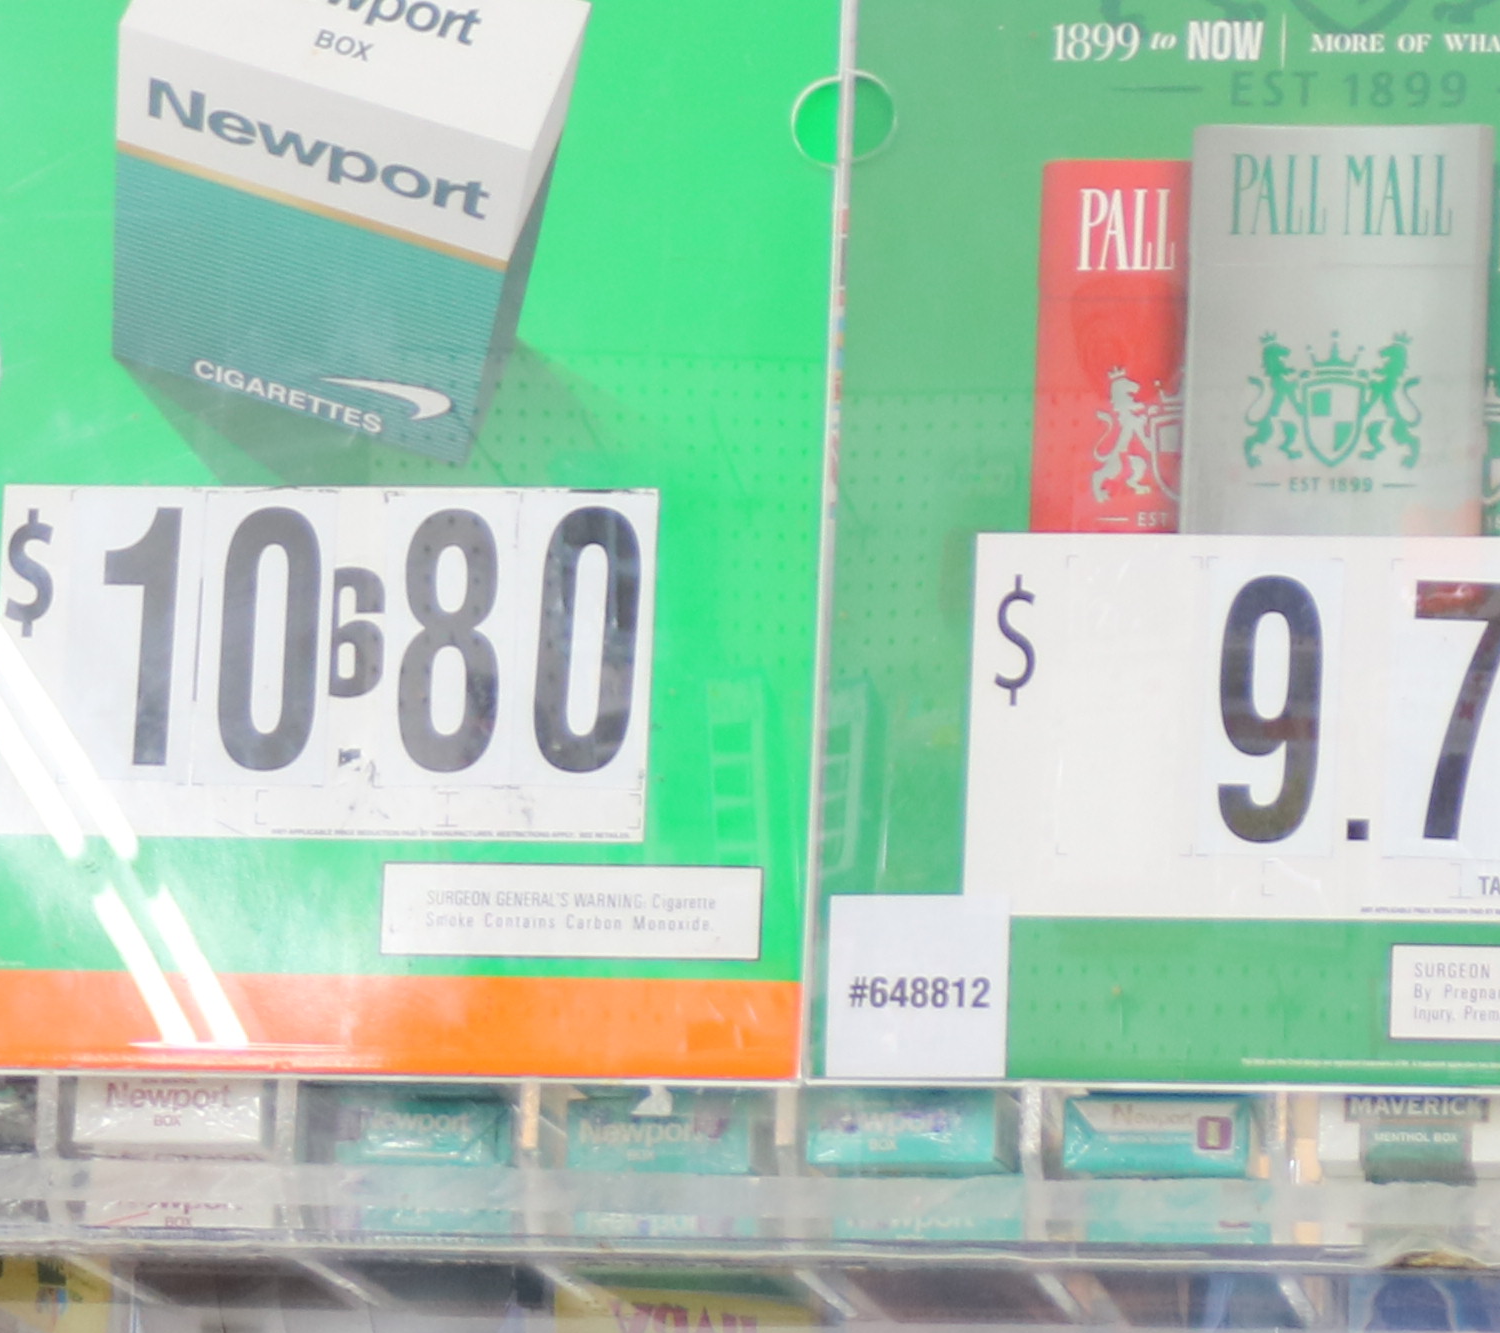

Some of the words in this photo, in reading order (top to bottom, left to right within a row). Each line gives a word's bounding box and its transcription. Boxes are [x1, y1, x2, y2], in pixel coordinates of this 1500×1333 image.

[314, 28, 374, 63] BOX
[1052, 23, 1140, 62] 1899
[1151, 31, 1178, 50] to
[1187, 22, 1263, 62] NOW
[1310, 31, 1384, 54] MORE
[1397, 32, 1432, 54] OF
[145, 76, 491, 221] Newport
[1229, 153, 1327, 237] PALL
[1345, 154, 1454, 238] MALL
[848, 974, 990, 1012] #648812
